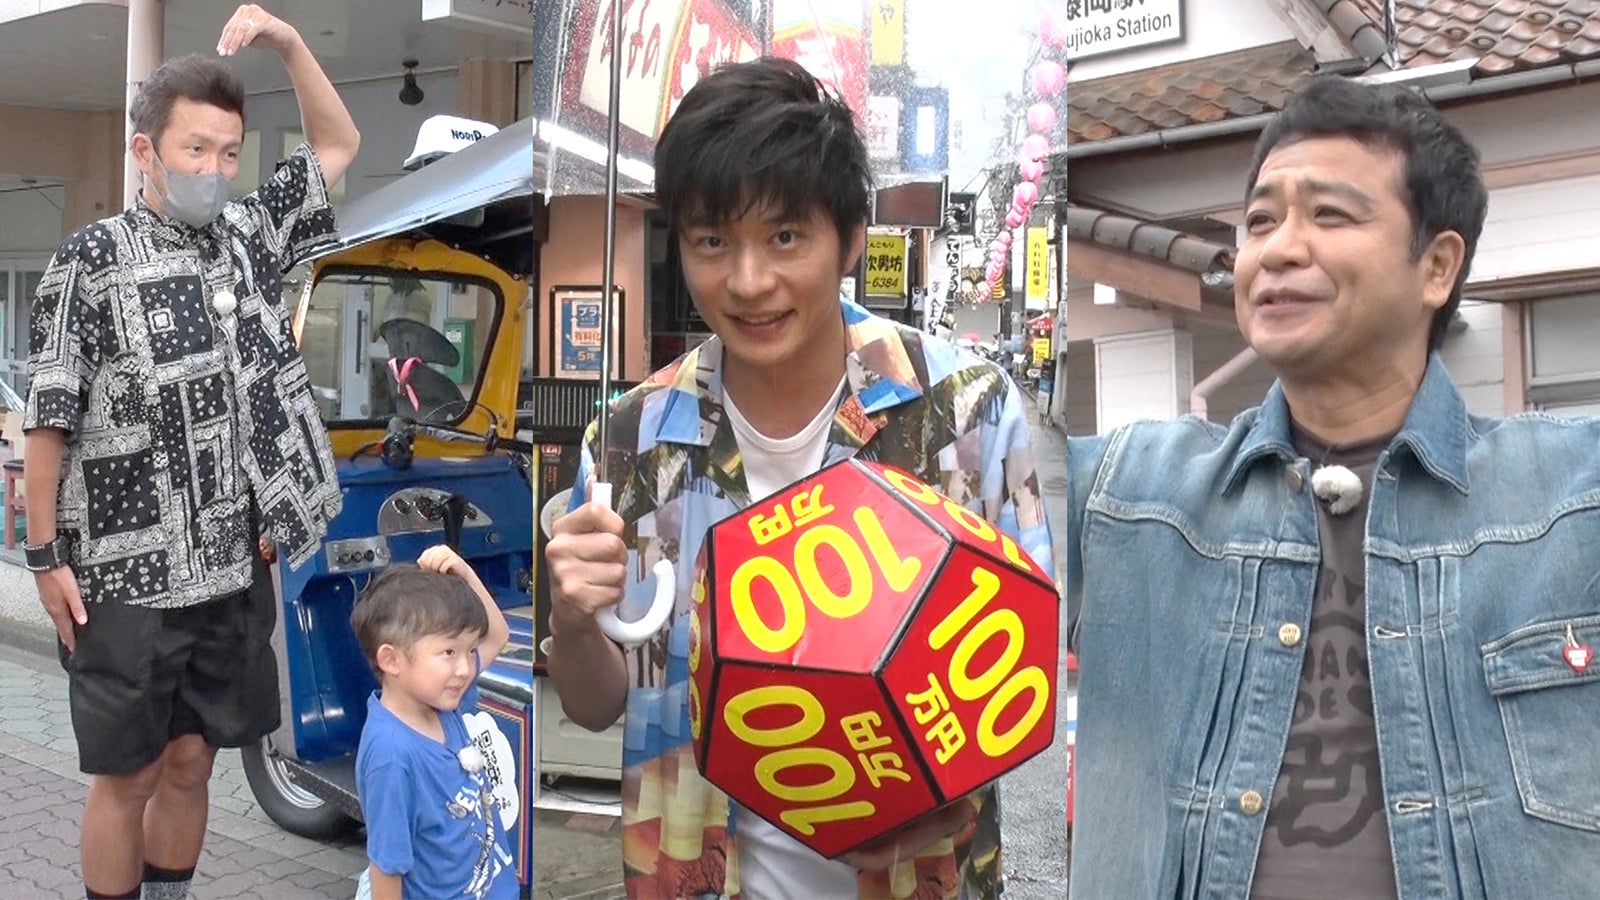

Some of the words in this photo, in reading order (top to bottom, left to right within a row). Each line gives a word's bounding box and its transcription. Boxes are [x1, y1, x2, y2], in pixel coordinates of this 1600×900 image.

[1116, 12, 1172, 38] Station
[748, 484, 835, 546] 万円
[730, 505, 922, 653] 100
[928, 566, 1050, 758] 100
[723, 684, 876, 837] 100
[839, 710, 912, 788] 万円
[905, 672, 967, 765] 万円
